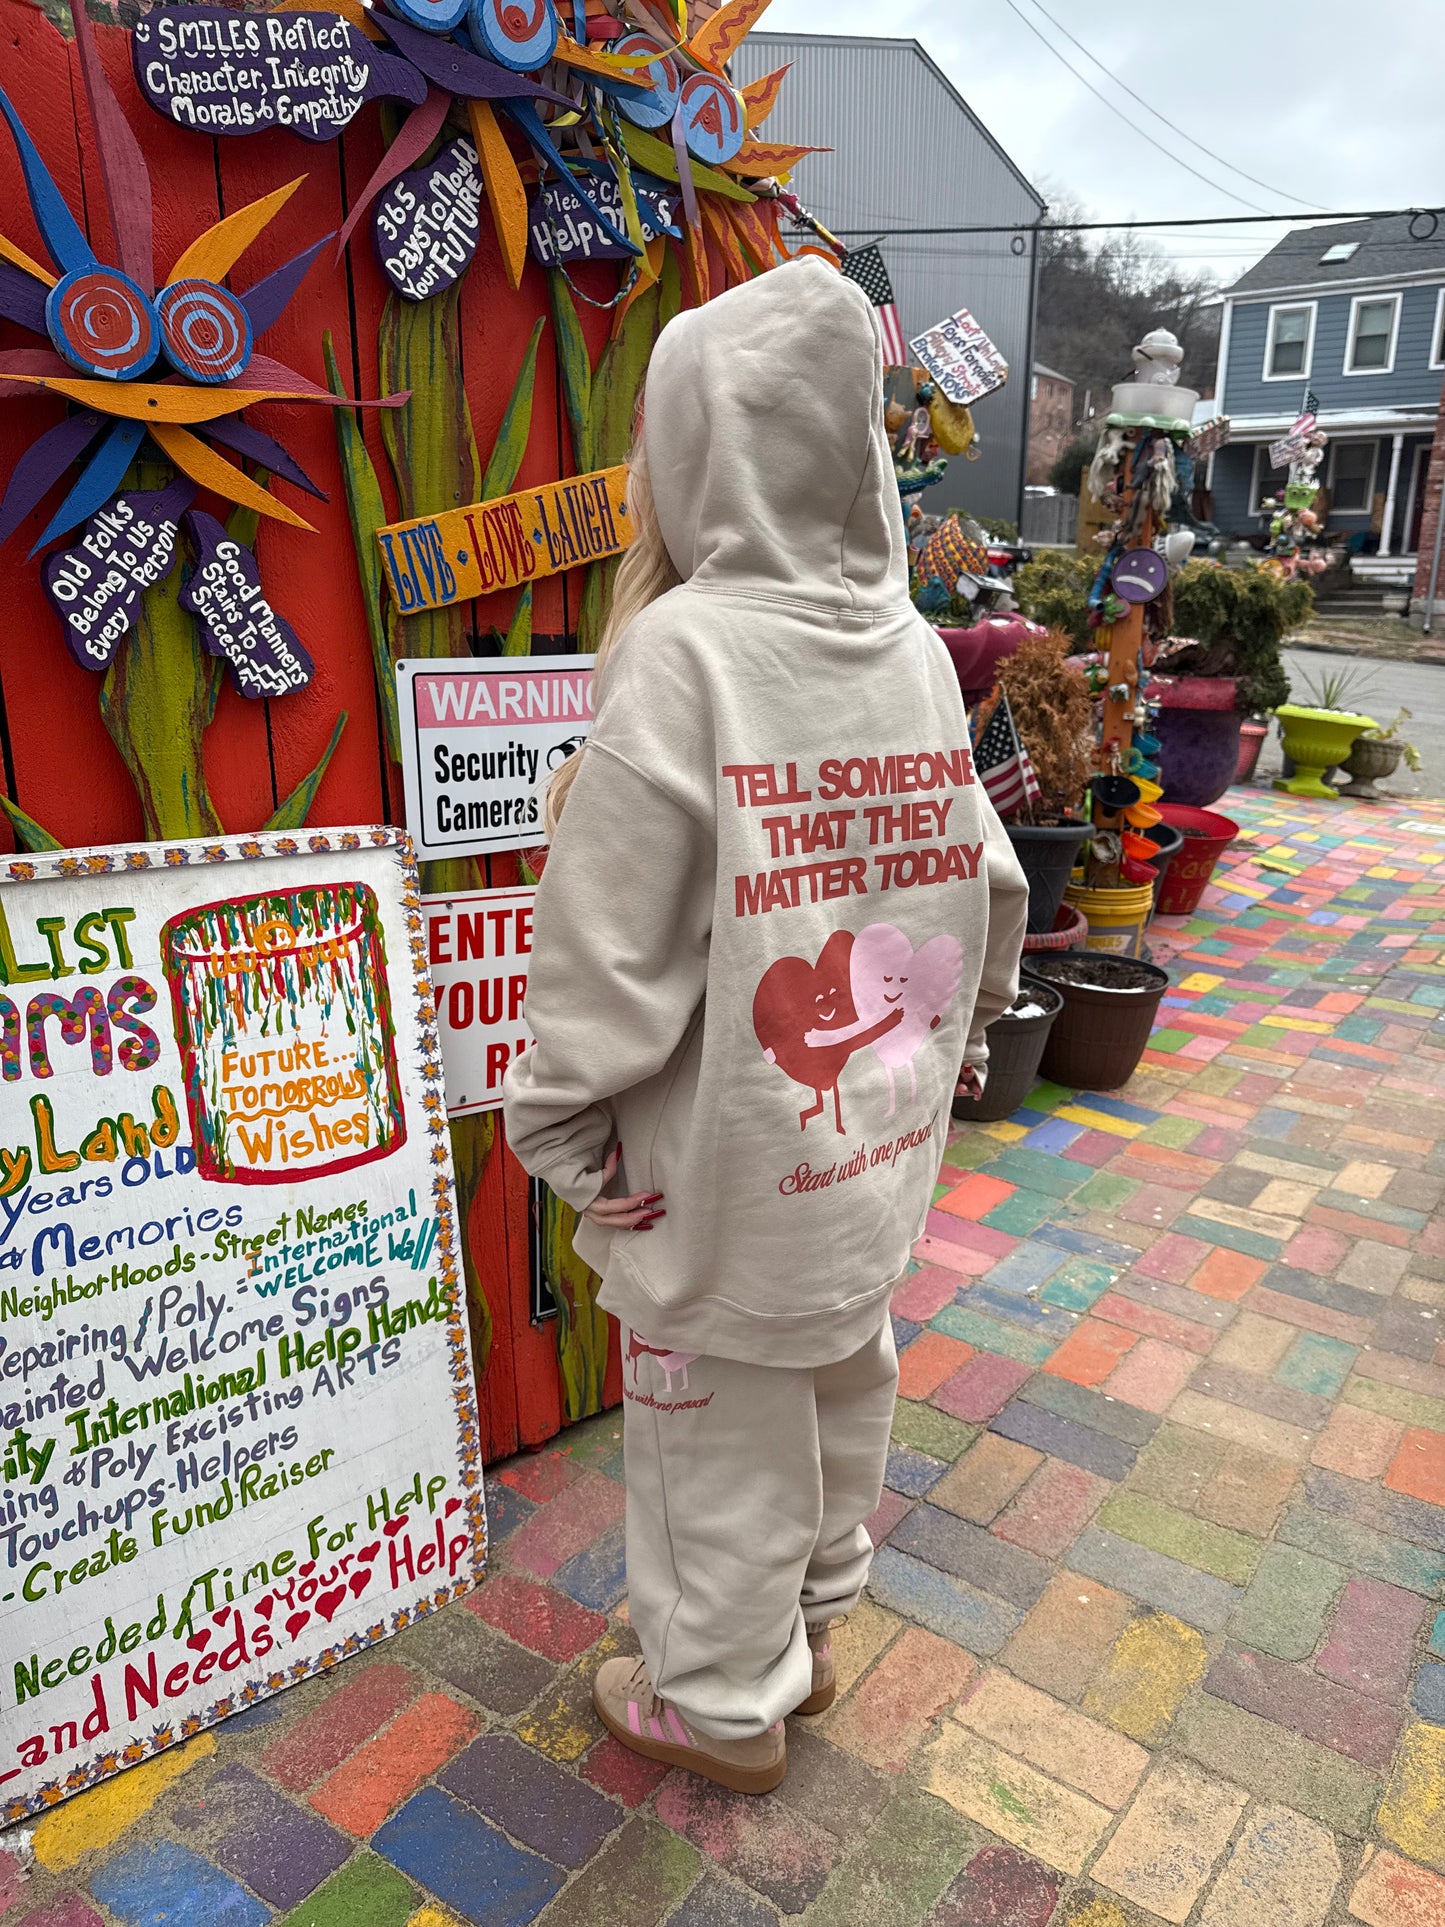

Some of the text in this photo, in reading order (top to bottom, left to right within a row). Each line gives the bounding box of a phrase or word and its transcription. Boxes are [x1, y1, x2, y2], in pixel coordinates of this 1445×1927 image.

[159, 15, 351, 52] SMILES Reflect
[146, 55, 369, 95] Character, Integrity
[170, 95, 255, 127] Morals
[277, 95, 364, 134] Empathy
[377, 181, 416, 241] 365
[385, 138, 479, 281] Days To Mould
[402, 173, 483, 300] Your FUTURE
[532, 214, 594, 261] Help
[912, 338, 970, 399] Broken Toys
[52, 500, 134, 601] Old Folks
[68, 520, 155, 635] Belong To Us
[380, 477, 620, 611] LIVE LOVE LAUGH
[85, 606, 130, 661] Every
[130, 519, 179, 587] Person
[191, 585, 248, 667] Success
[202, 562, 258, 650] Stairs To
[215, 541, 309, 685] Good Manners
[434, 741, 539, 785] Security
[722, 748, 976, 807] TELL SOMEONE
[436, 795, 539, 833] Cameras
[761, 798, 954, 858] THAT THEY
[735, 842, 984, 918] MATTER TODAY
[0, 899, 137, 987] LIST
[221, 1068, 369, 1111] TOMORROWS
[29, 1084, 181, 1175] Land
[121, 1145, 197, 1187] OLD
[236, 1112, 370, 1164] Wishes
[778, 1162, 837, 1196] Start
[836, 1142, 868, 1184] with
[870, 1141, 894, 1168] one
[31, 1204, 243, 1277] Memories
[245, 1188, 417, 1279] International
[297, 1200, 368, 1239] Names
[254, 1234, 382, 1298] WELCOME
[0, 1323, 127, 1382] epairing
[0, 1276, 389, 1430] ainted Welcome Signs
[0, 1427, 57, 1485] ity
[278, 1326, 362, 1379] Help
[367, 1276, 456, 1344] Hands
[0, 1483, 59, 1527] ing
[91, 1440, 157, 1488] Poly
[166, 1385, 304, 1456] Excisting
[312, 1337, 401, 1398] ARTS
[307, 1515, 358, 1560] For
[366, 1472, 446, 1530] Help
[124, 1609, 274, 1721] Needs
[388, 1518, 469, 1589] Help
